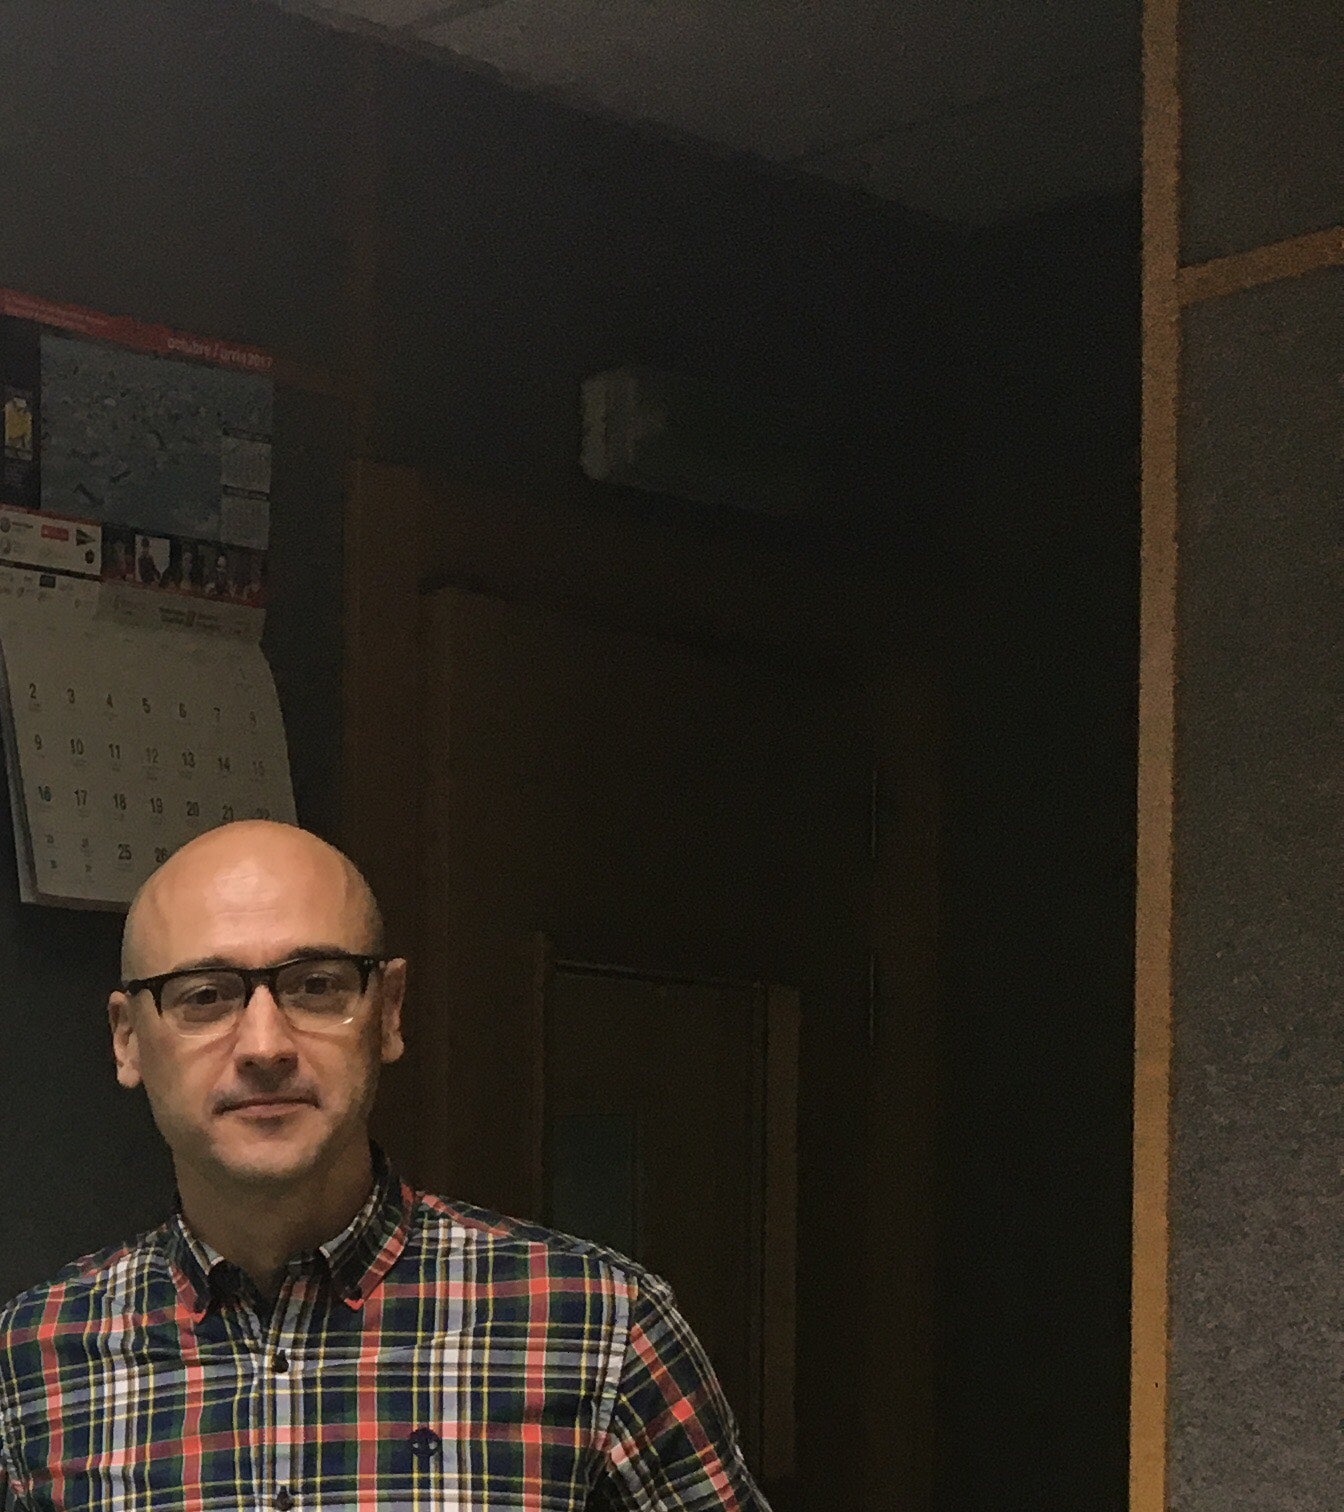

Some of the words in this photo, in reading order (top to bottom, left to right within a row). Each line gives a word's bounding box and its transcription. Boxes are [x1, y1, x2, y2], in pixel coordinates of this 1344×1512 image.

[29, 683, 37, 699] 2
[67, 688, 75, 704] 3
[142, 698, 151, 713] 5
[178, 702, 187, 718] 6
[35, 734, 43, 750] 9
[70, 737, 84, 756] 10
[109, 742, 121, 759] 11
[146, 747, 159, 763] 12
[182, 751, 195, 768] 13
[74, 789, 88, 806] 17
[113, 793, 127, 811] 18
[150, 797, 163, 815] 19
[186, 801, 200, 818] 20
[118, 843, 132, 860] 25
